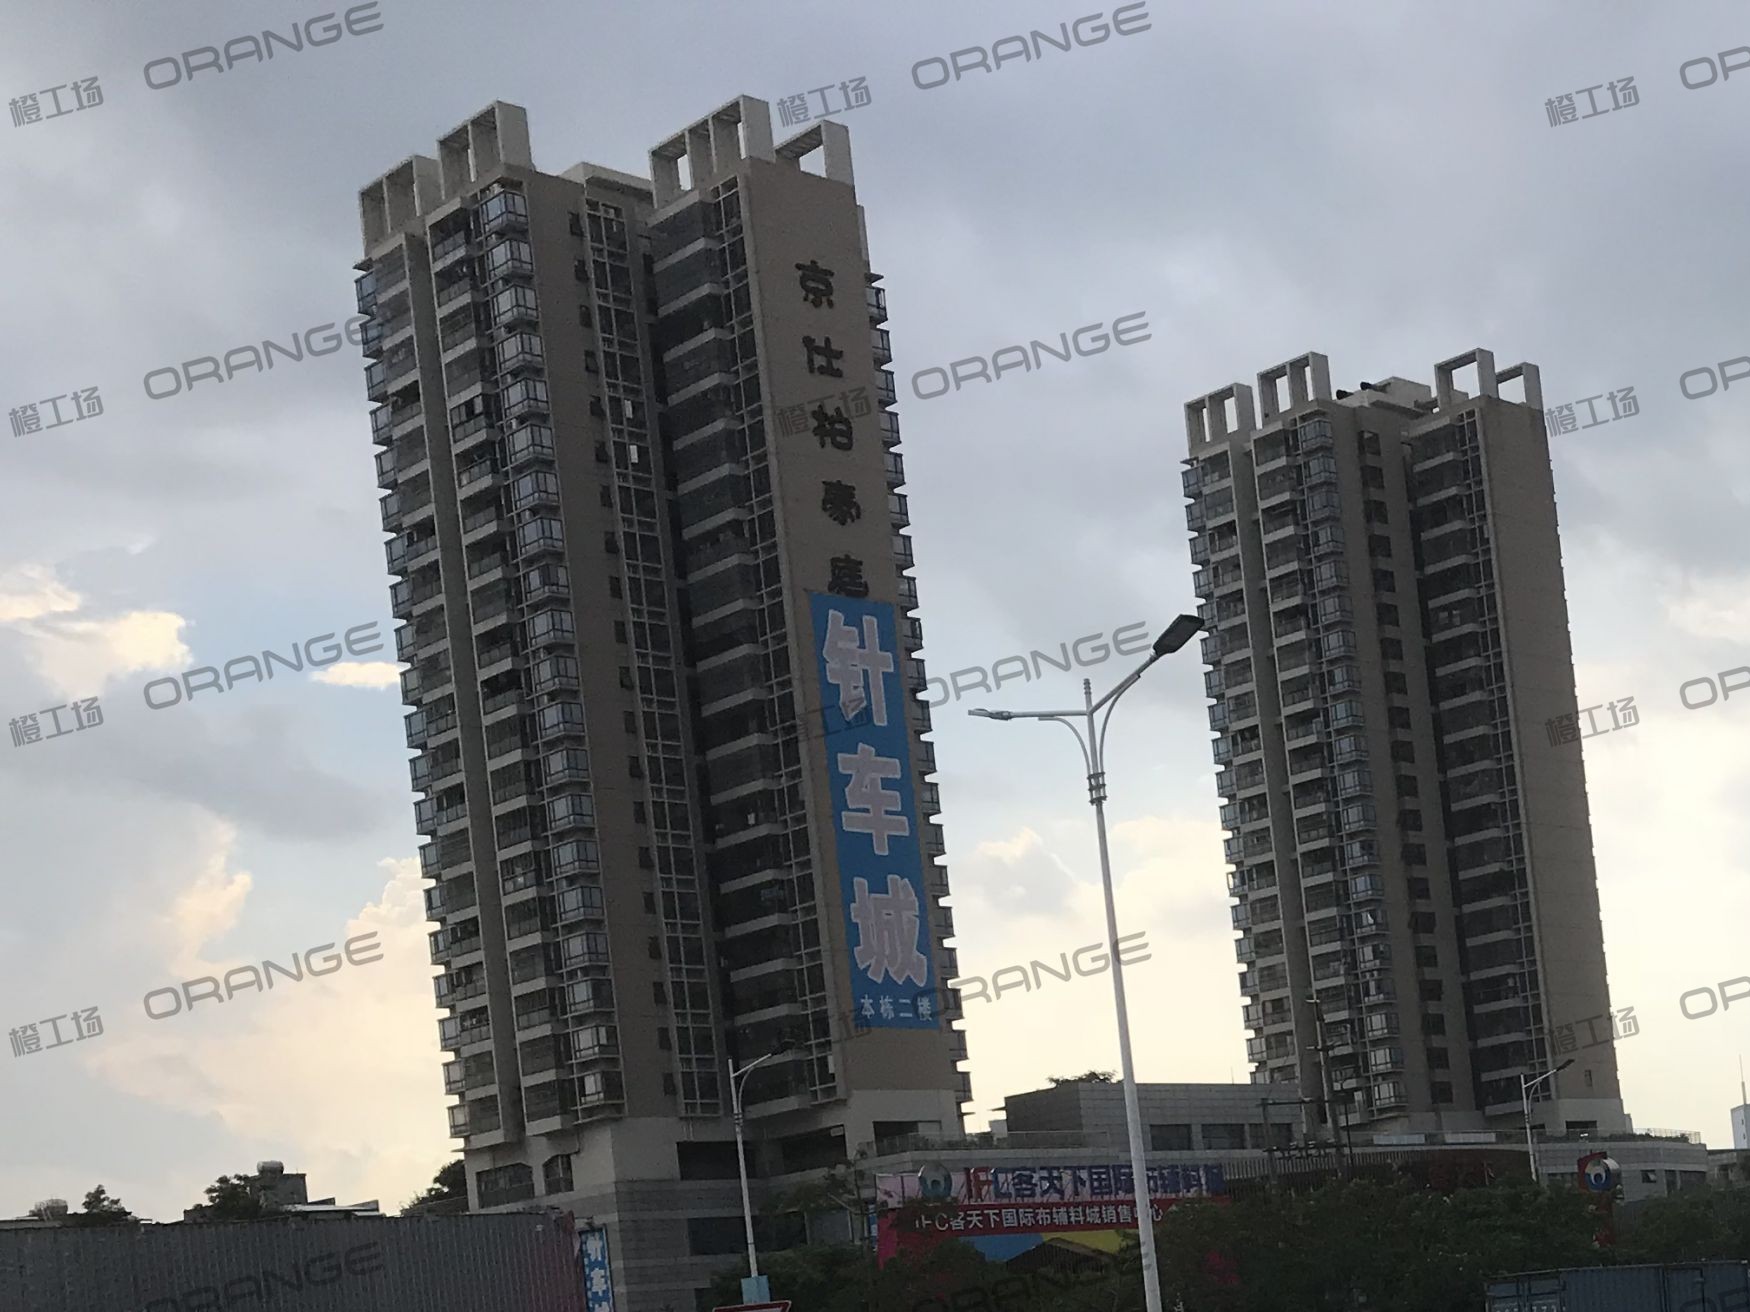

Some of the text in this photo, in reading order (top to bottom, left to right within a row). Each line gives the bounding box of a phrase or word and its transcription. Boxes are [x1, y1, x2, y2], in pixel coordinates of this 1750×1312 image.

[822, 609, 927, 987] 针车城
[861, 993, 934, 1022] 本栋二楼
